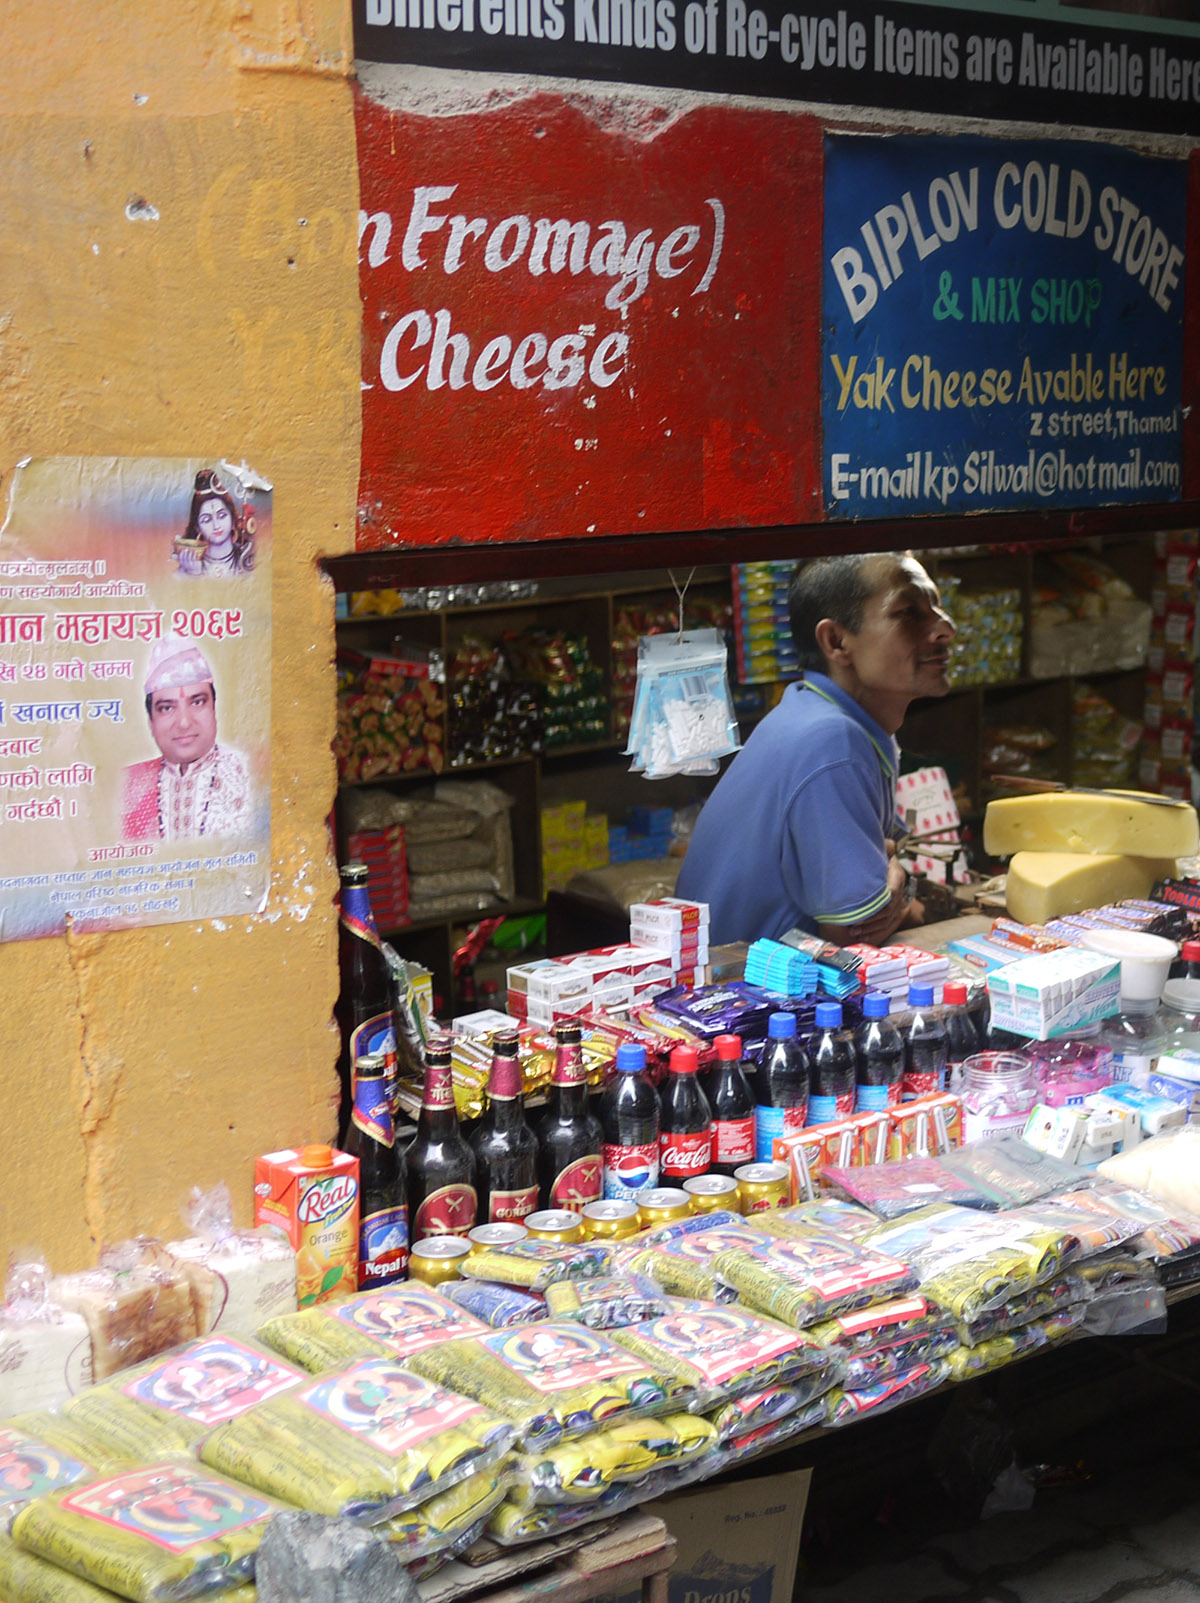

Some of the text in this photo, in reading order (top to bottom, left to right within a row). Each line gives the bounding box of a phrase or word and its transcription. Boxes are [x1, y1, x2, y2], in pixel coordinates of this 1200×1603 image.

[684, 0, 719, 55] of
[725, 0, 867, 72] Re-cycle
[874, 14, 960, 80] Items
[966, 34, 1013, 86] are
[1018, 32, 1143, 98] Available
[402, 182, 726, 311] Fromage)
[830, 159, 1186, 325] BIPLOV COLD STORE
[932, 269, 964, 321] &
[380, 307, 630, 392] Cheese
[830, 351, 1167, 414] Yak Cheese Avable Here
[54, 659, 84, 680] गते
[12, 702, 81, 723] खनाल
[47, 765, 94, 787] लागि
[304, 1176, 352, 1227] Real
[309, 1229, 349, 1247] Orange
[364, 1258, 400, 1277] Nepal
